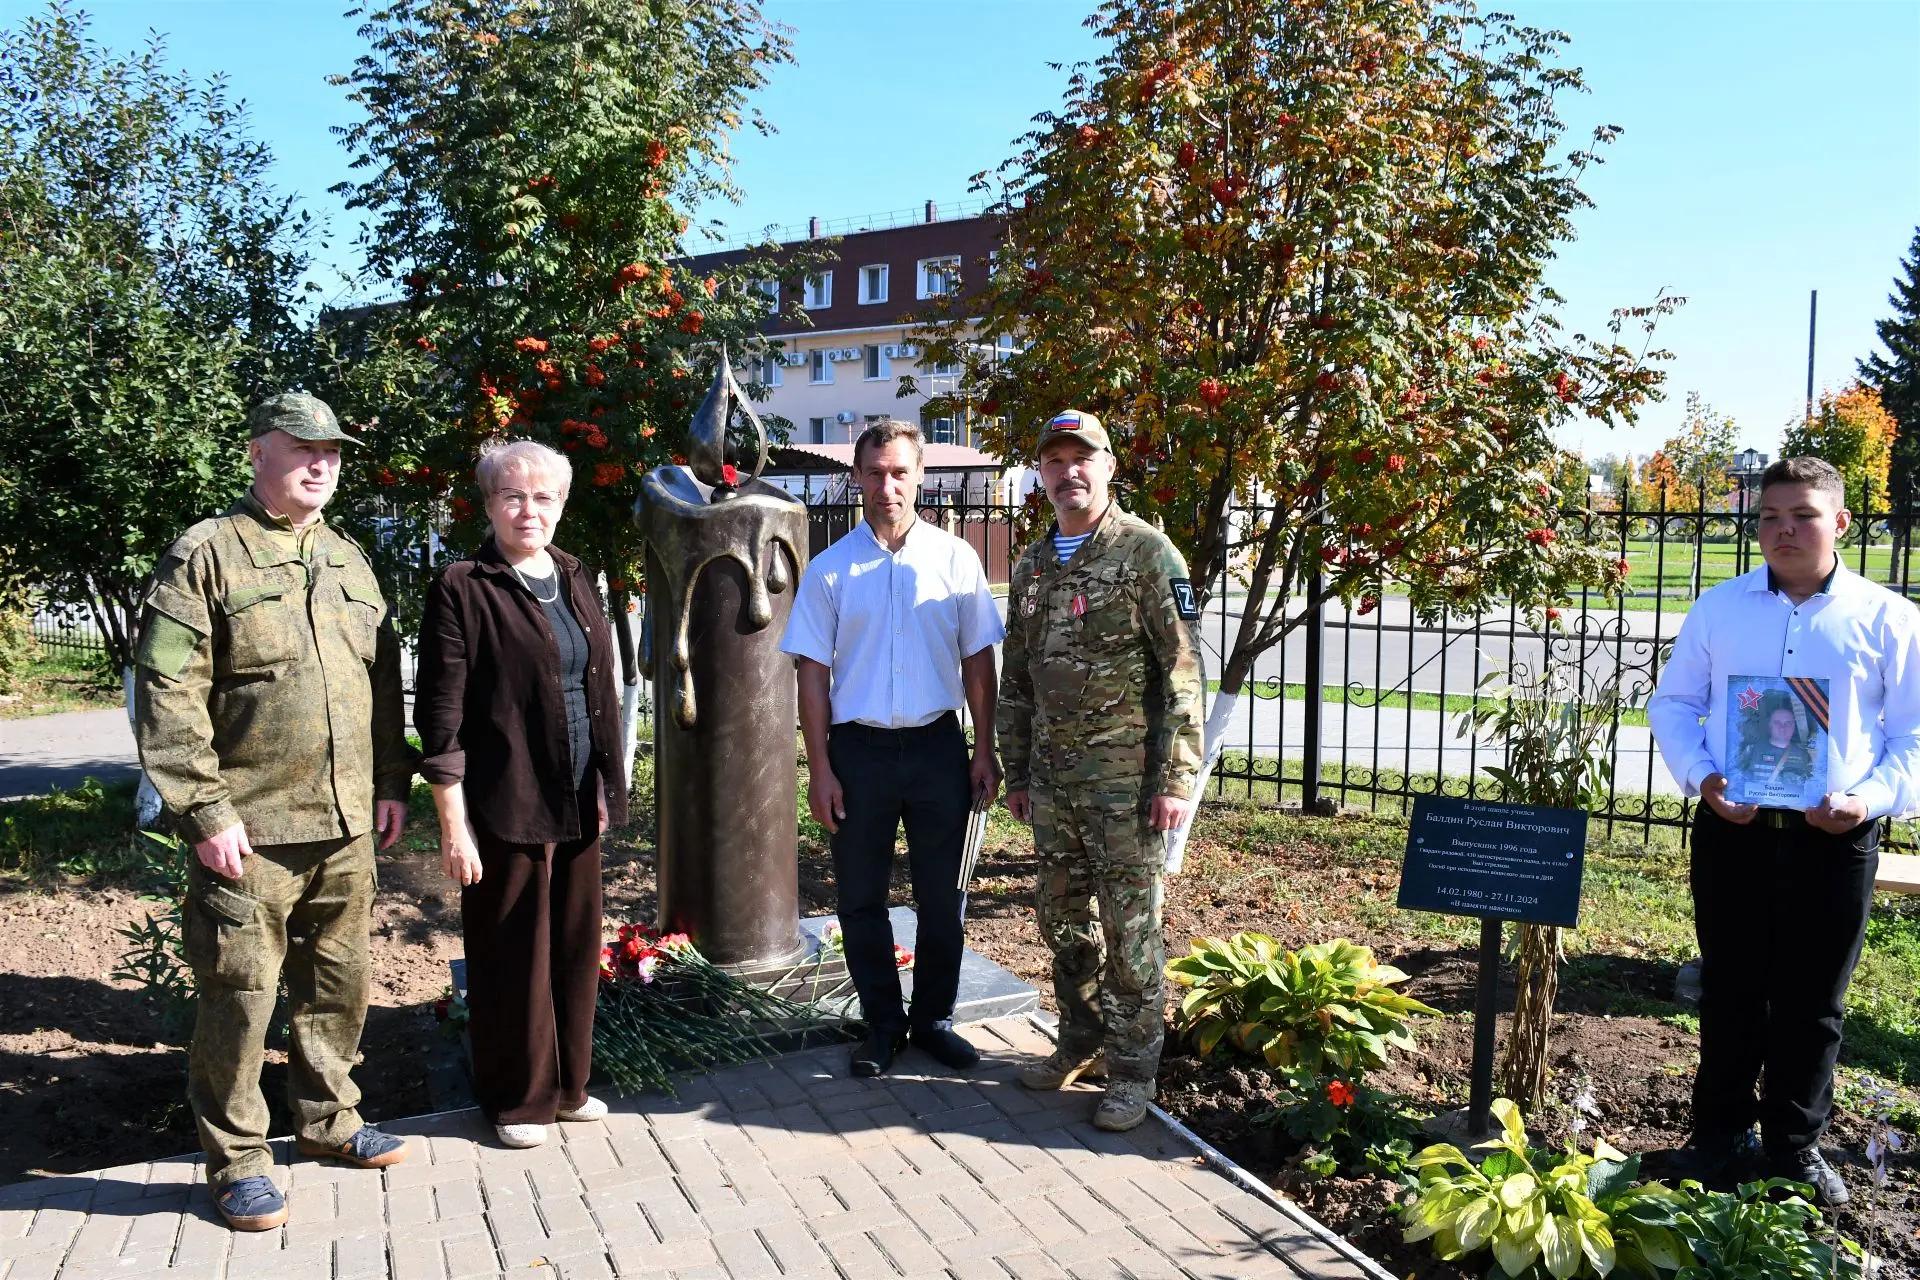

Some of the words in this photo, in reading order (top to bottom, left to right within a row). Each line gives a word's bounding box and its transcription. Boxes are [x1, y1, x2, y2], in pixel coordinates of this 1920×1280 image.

[1178, 587, 1195, 610] Z
[1510, 808, 1535, 817] учился
[1426, 812, 1464, 825] Балдин
[1466, 816, 1503, 829] Руслан
[1505, 820, 1570, 835] Викторович
[1451, 838, 1498, 851] Выпускник
[1499, 843, 1518, 852] 1996
[1519, 846, 1538, 855] года
[1436, 886, 1483, 899] 14.02.1980
[1490, 892, 1539, 905] 27.11.2024
[1461, 902, 1488, 911] памяти
